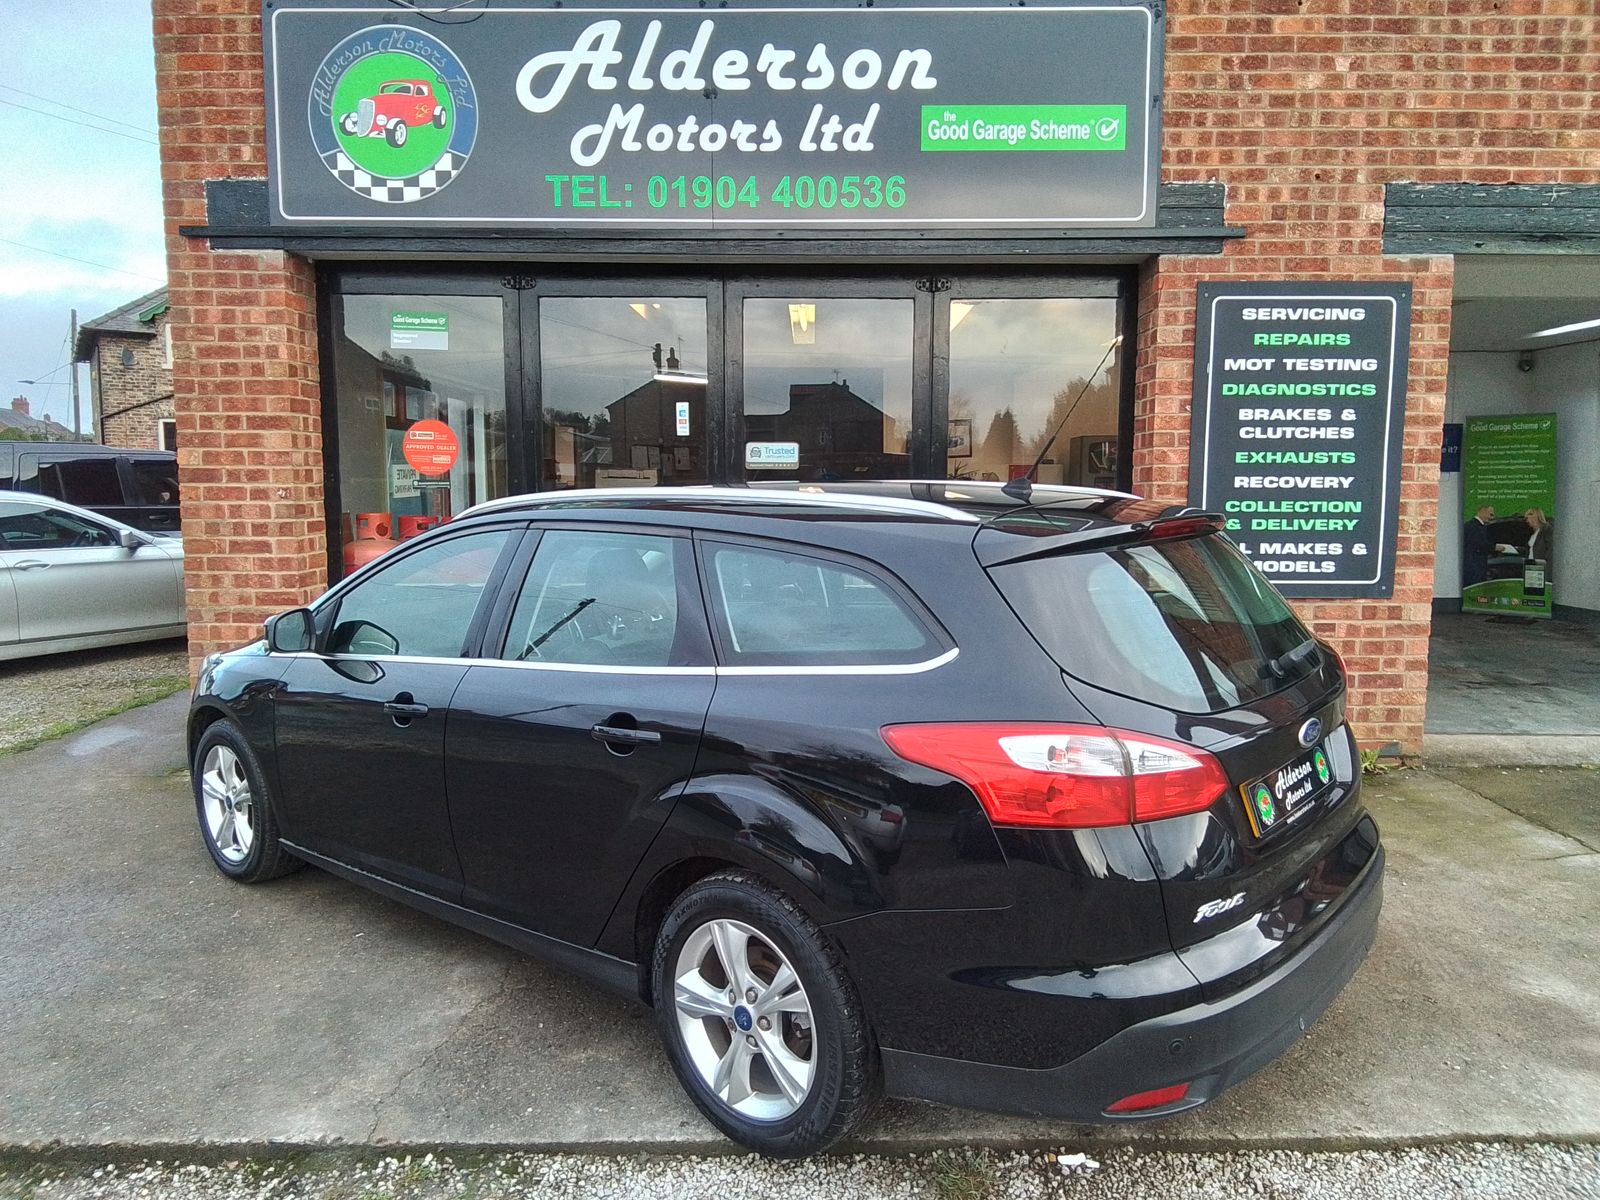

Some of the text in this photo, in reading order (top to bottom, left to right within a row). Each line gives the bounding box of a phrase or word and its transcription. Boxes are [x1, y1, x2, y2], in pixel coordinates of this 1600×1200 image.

[515, 19, 938, 113] Alderson
[313, 40, 373, 117] Alderson
[378, 30, 446, 68] Motors
[943, 110, 957, 122] the
[570, 102, 881, 167] Motors ltd
[927, 118, 1091, 145] Good Garage Scheme
[545, 174, 906, 208] TEL: 01904 400536
[1241, 307, 1366, 321] SERVICING
[1253, 333, 1351, 346] REPAIRS
[1224, 358, 1378, 371] MOT TESTING
[1221, 383, 1377, 396] DIAGNOSTICS
[1238, 408, 1357, 421] BRAKES &
[1239, 426, 1355, 439] CLUTCHES
[764, 446, 795, 455] Trusted
[1235, 451, 1356, 464] EXHAUSTS
[1234, 476, 1355, 489] RECOVERY
[1225, 500, 1362, 513] COLLECTION
[1226, 518, 1359, 531] & DELIVERY
[1259, 542, 1343, 555] MAKES
[1351, 543, 1368, 556] &
[1275, 761, 1312, 799] Alderson
